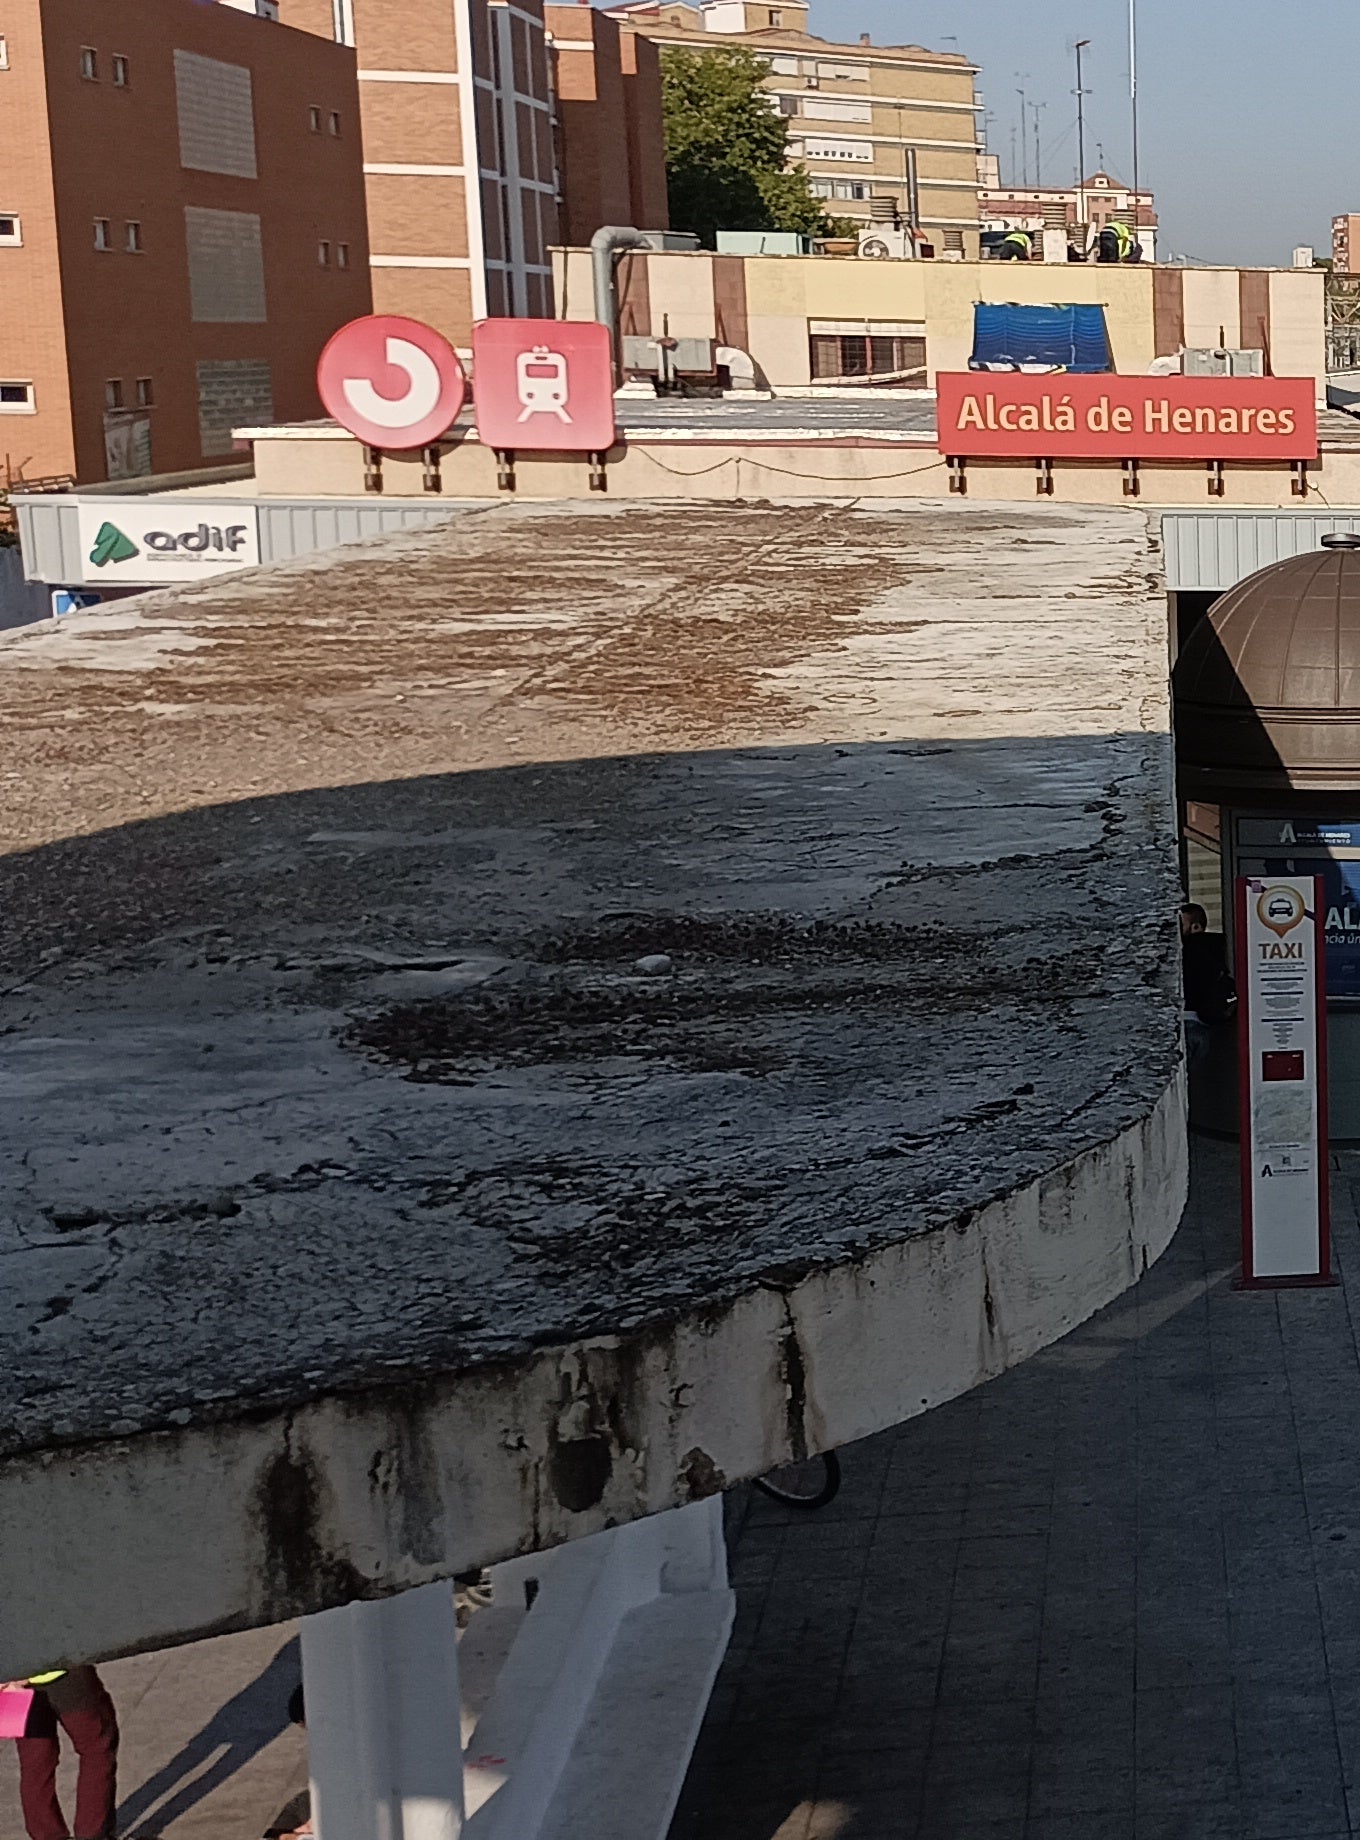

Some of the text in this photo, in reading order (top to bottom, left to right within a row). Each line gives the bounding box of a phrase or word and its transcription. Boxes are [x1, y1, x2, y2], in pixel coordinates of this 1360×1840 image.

[956, 395, 1296, 434] Alcalá de Henares
[143, 523, 248, 552] adif
[1258, 943, 1303, 960] TAXI
